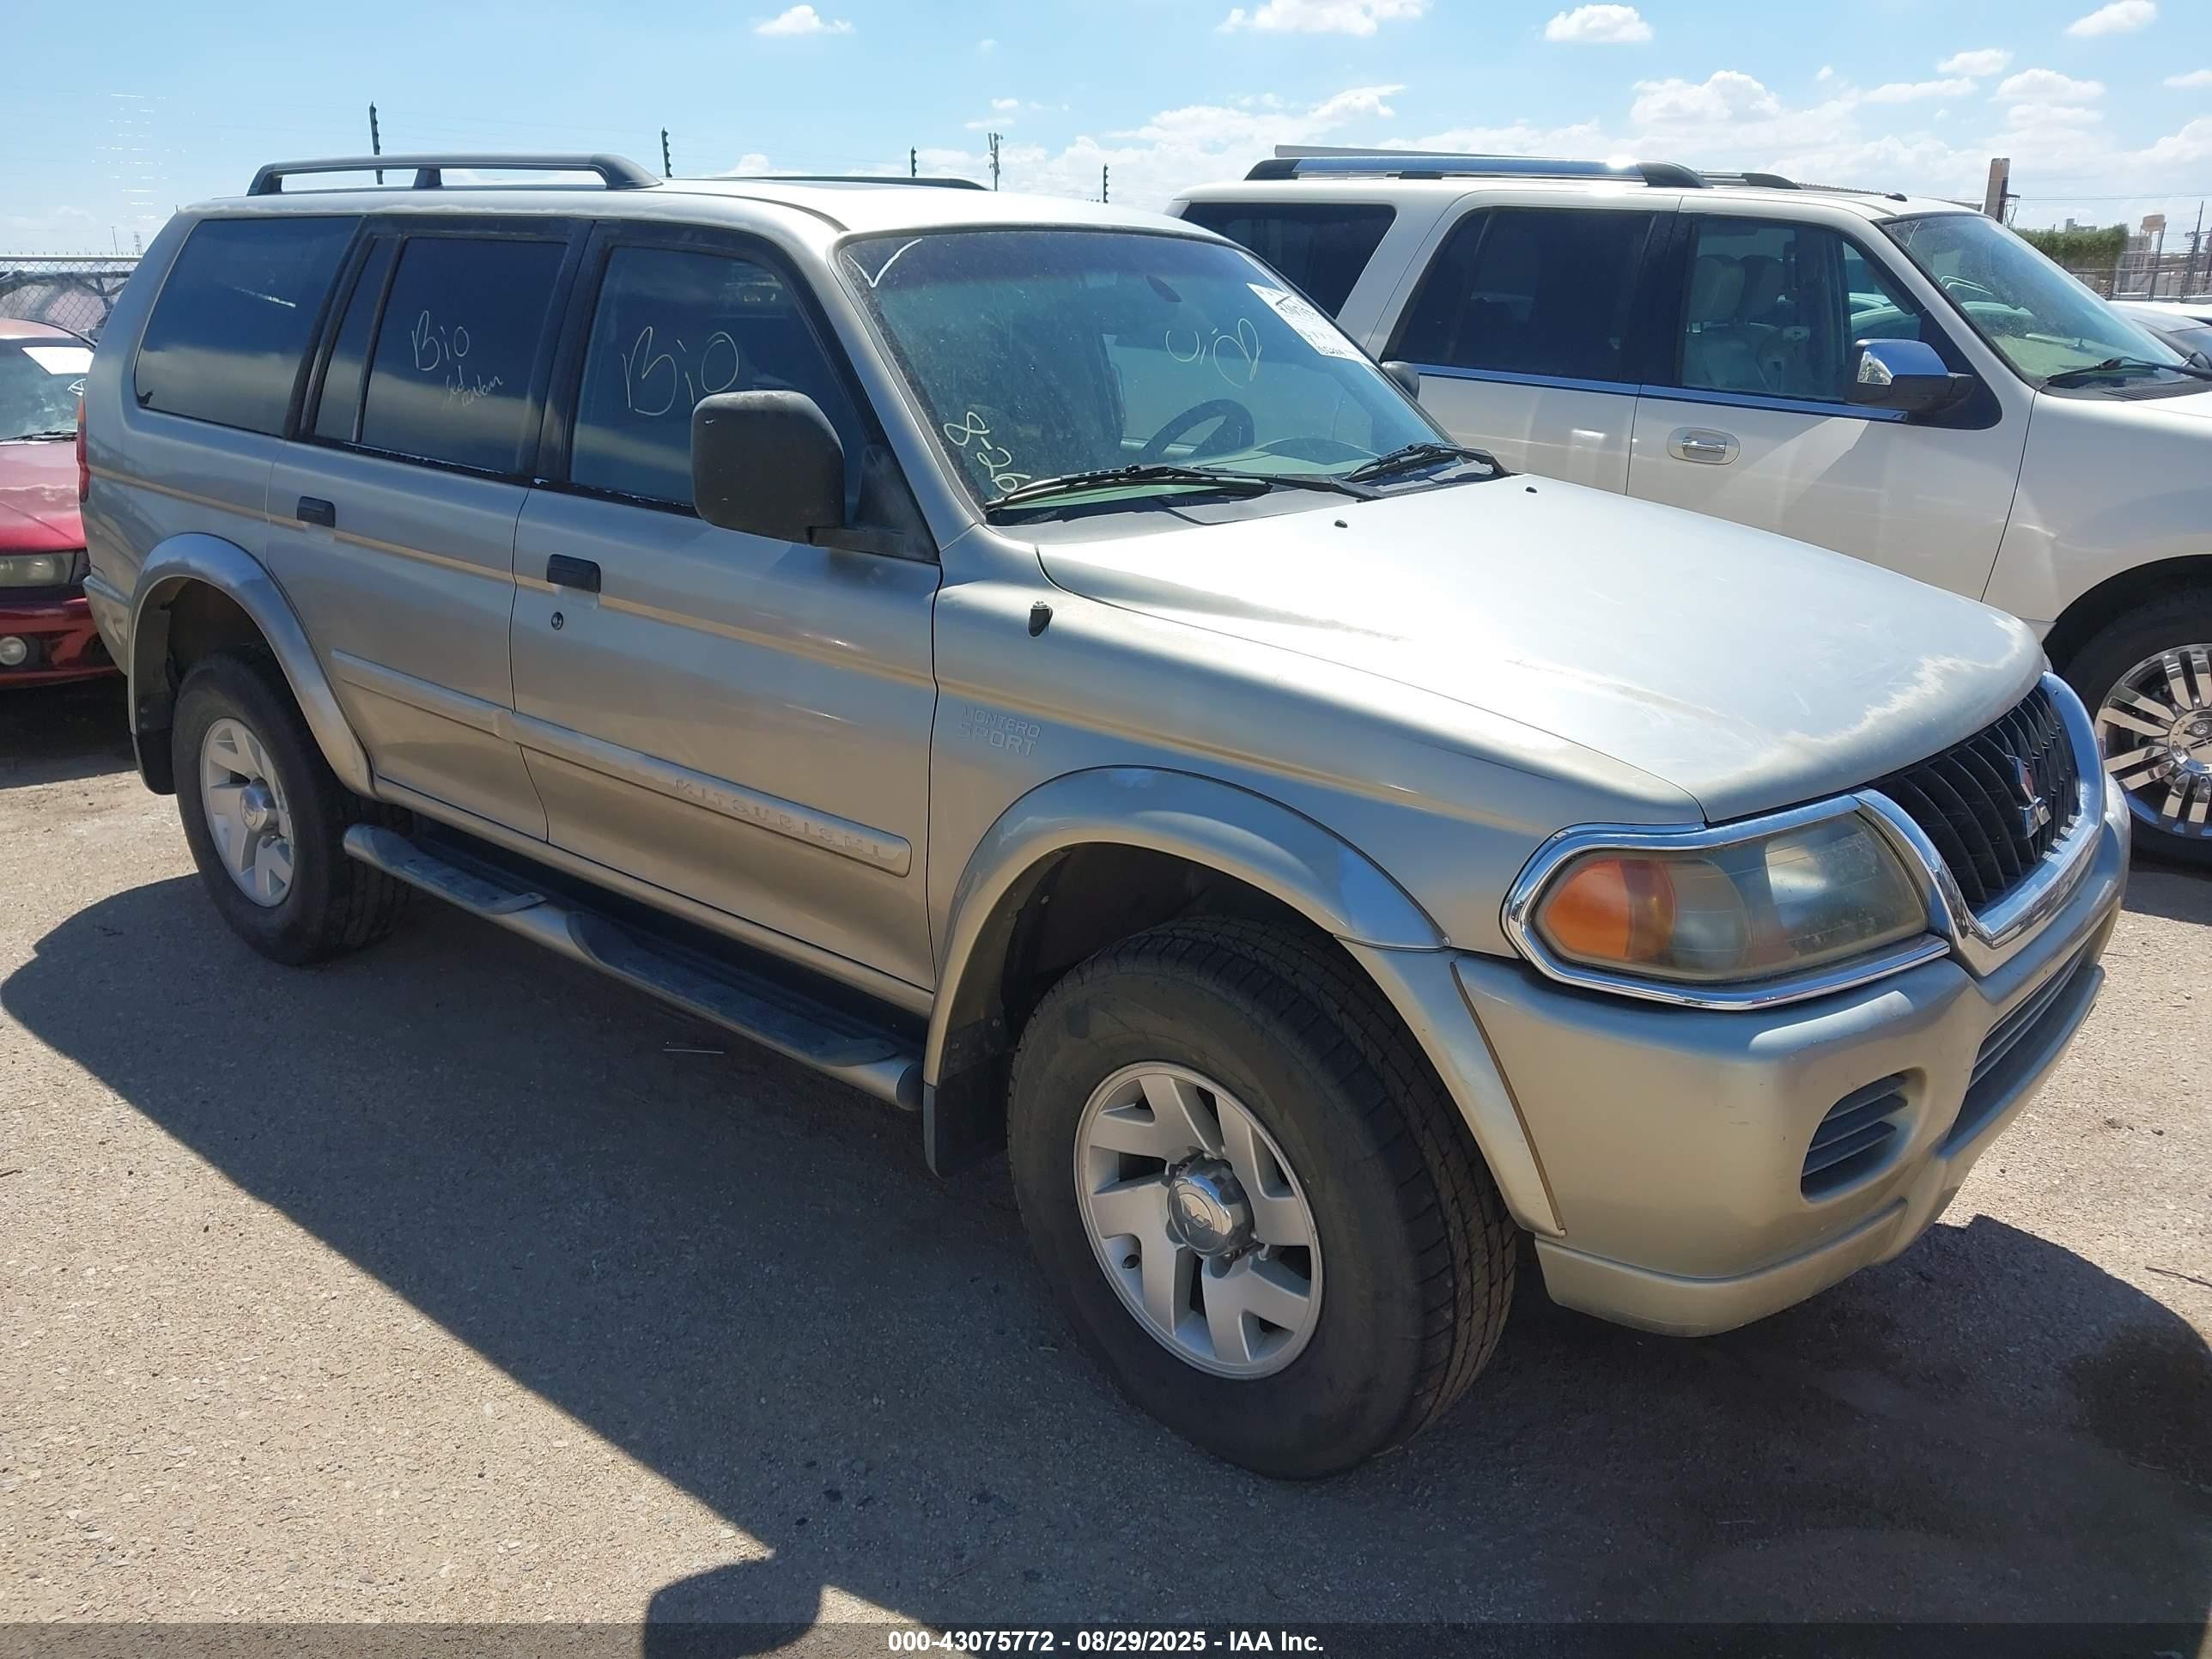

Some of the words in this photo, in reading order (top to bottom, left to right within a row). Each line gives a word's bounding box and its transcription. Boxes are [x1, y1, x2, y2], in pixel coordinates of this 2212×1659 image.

[957, 722, 1037, 757] SPORT
[961, 706, 1042, 738] MONTERO
[673, 778, 881, 859] MITSUBISHI
